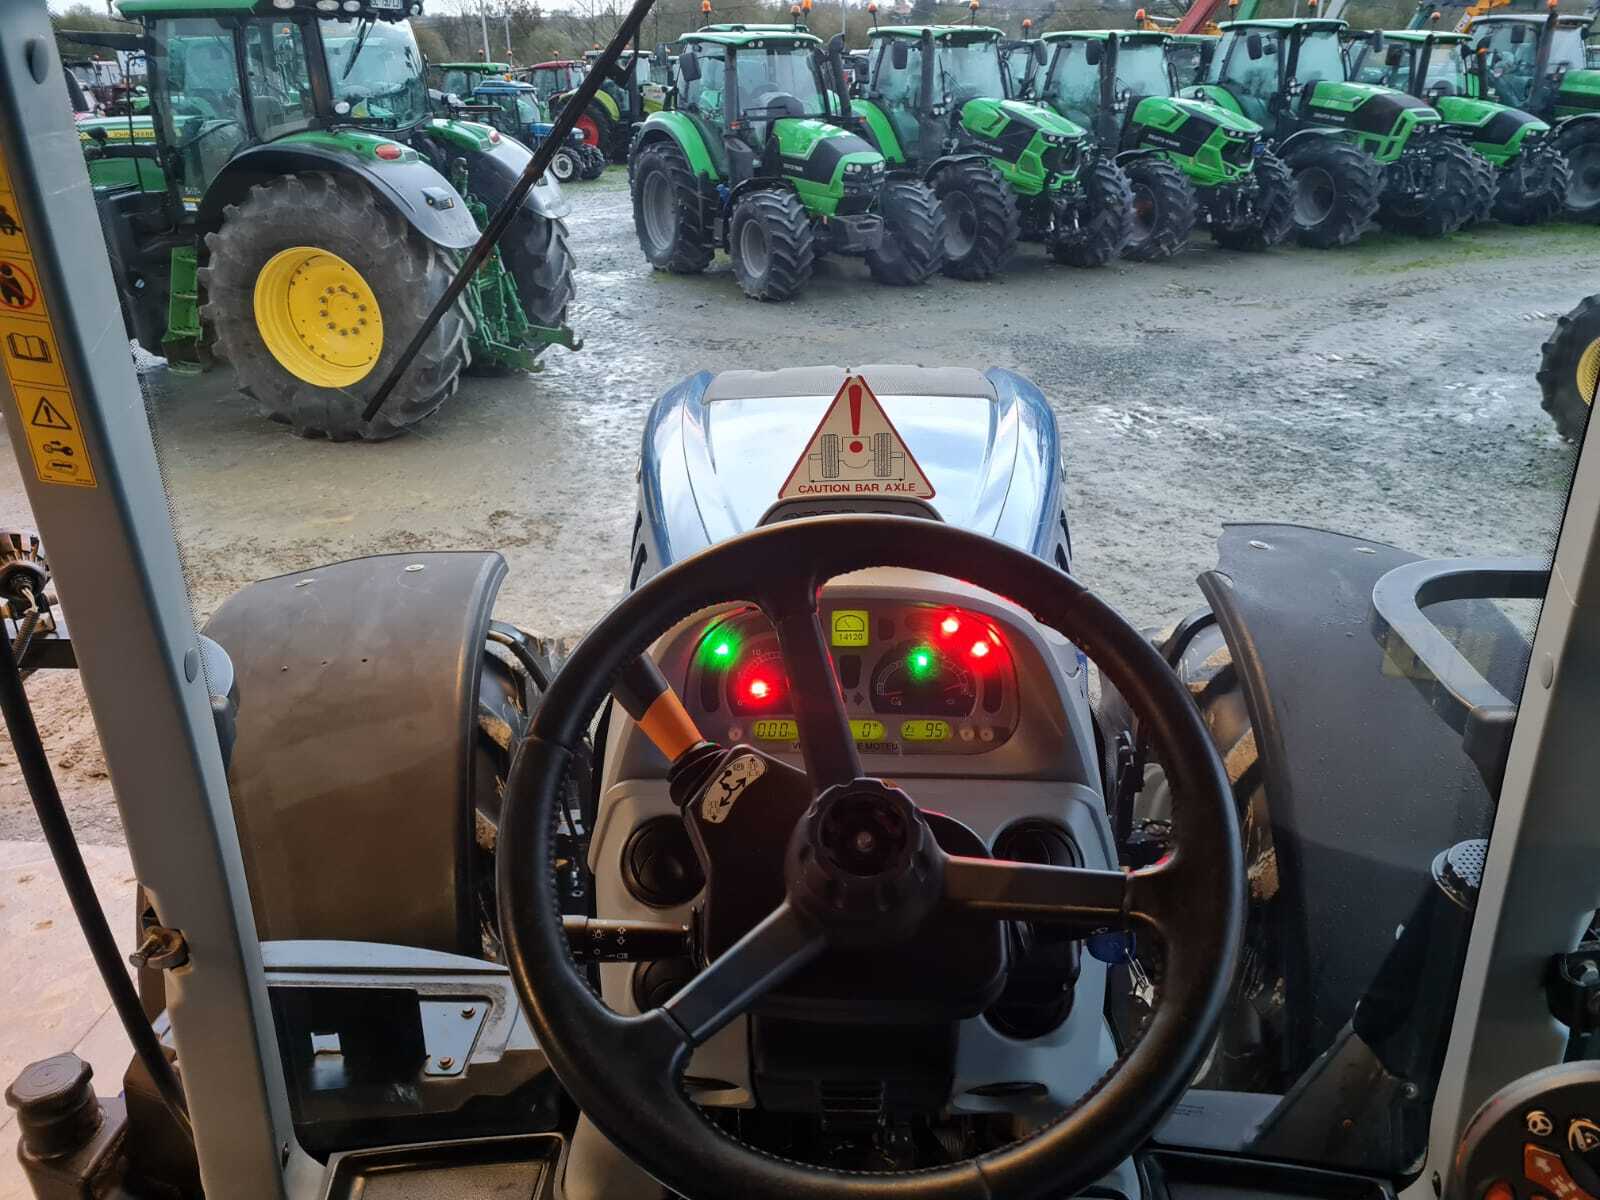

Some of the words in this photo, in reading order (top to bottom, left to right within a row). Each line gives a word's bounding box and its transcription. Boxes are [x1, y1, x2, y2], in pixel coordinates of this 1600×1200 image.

[798, 484, 850, 494] CAUTION
[855, 483, 879, 492] BAR
[885, 482, 916, 492] AXLE
[839, 633, 863, 641] 14120
[925, 722, 943, 737] 95
